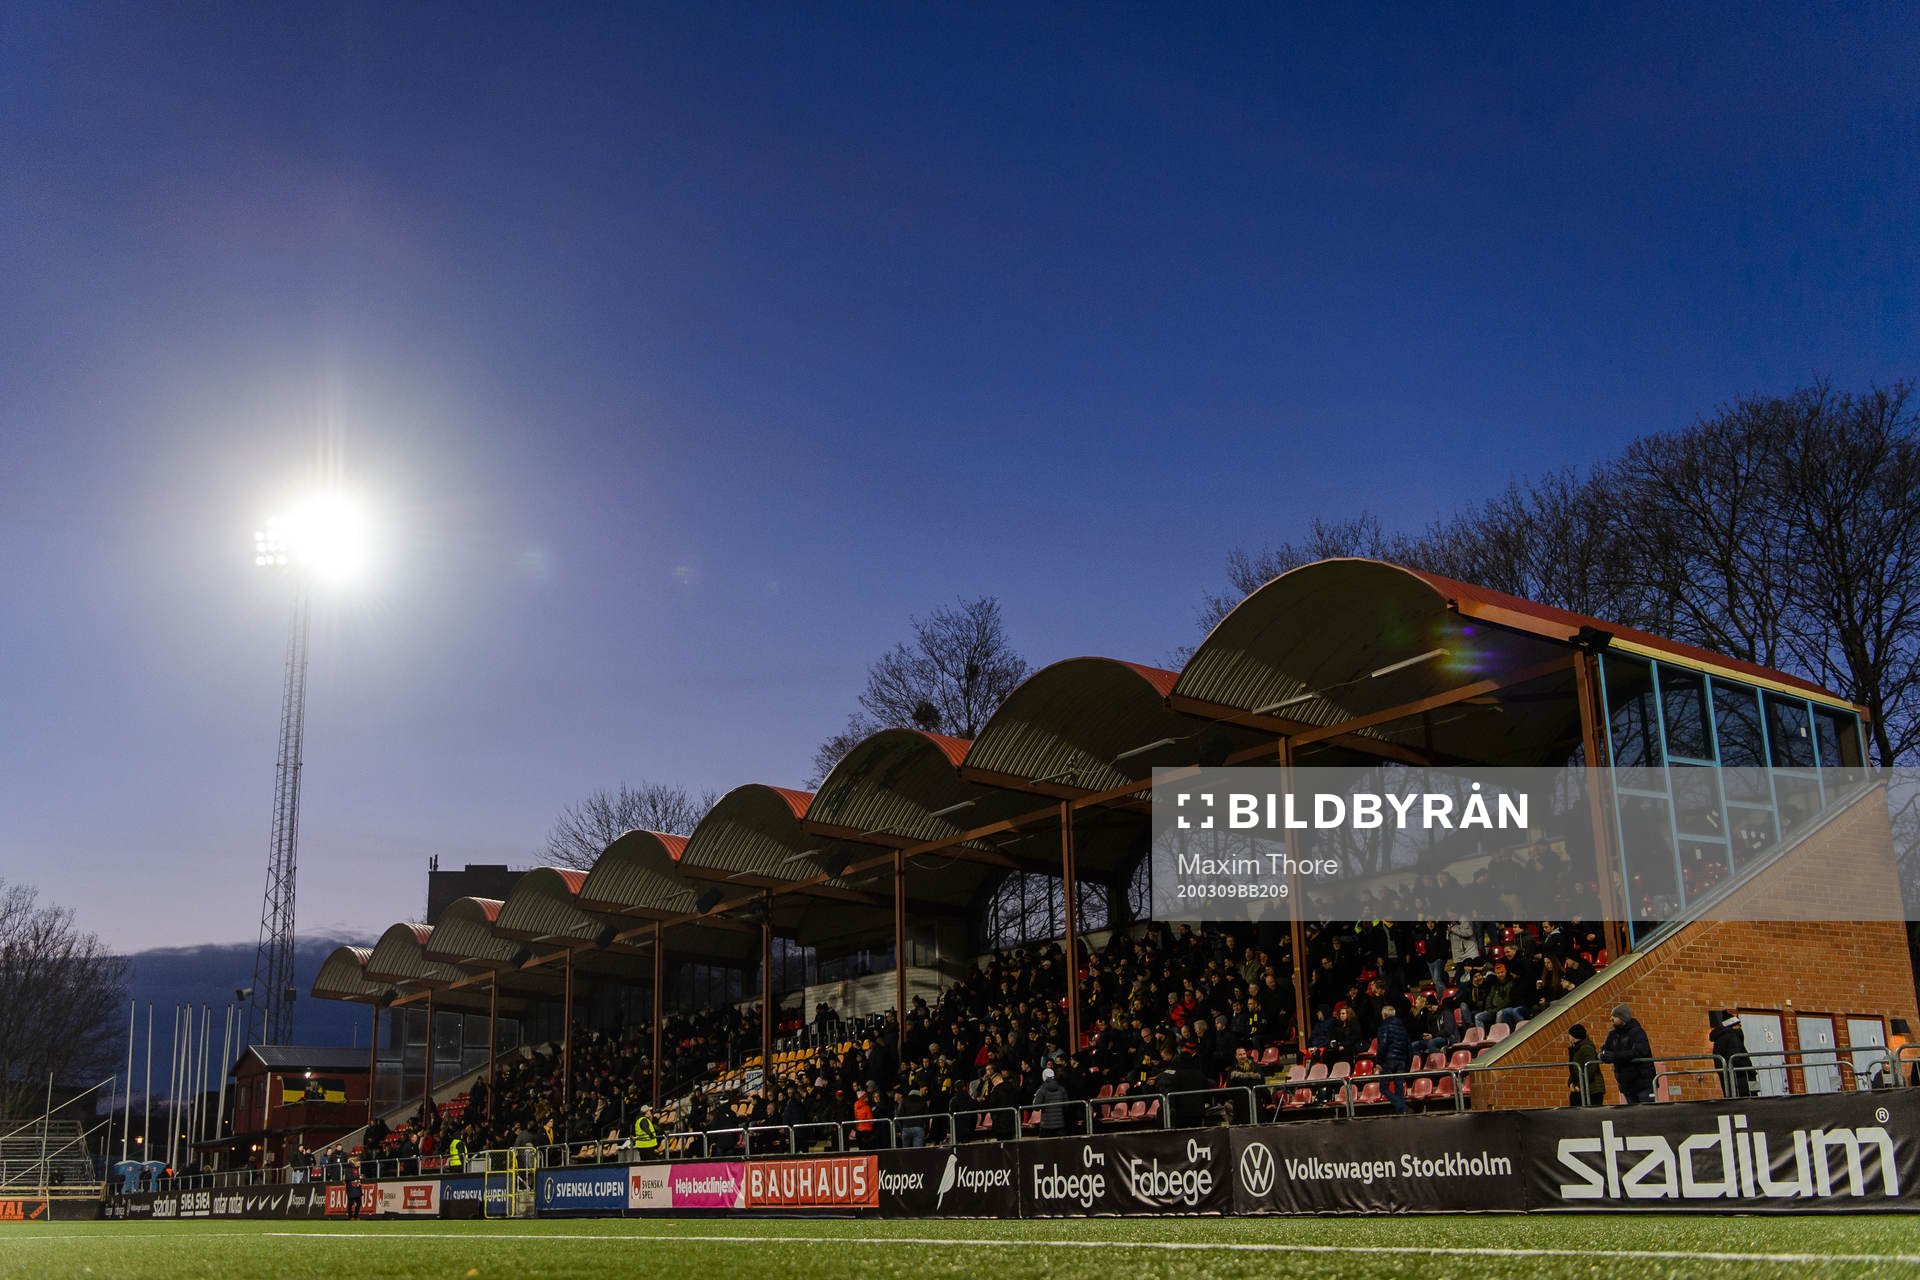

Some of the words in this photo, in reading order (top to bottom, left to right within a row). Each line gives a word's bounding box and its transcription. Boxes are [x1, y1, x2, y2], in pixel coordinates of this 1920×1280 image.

[1285, 1157, 1396, 1184] Volkswagen
[1400, 1151, 1512, 1178] Stockholm
[1556, 1114, 1899, 1198] stadium
[556, 1182, 593, 1197] SVENSKA
[594, 1181, 624, 1196] CUPEN
[642, 1180, 664, 1189] SVENSKA
[675, 1177, 692, 1197] Heja
[751, 1165, 866, 1198] BAUHAUS
[878, 1168, 924, 1194] Kappex
[957, 1164, 1012, 1193] Kappex
[1034, 1163, 1106, 1208] Fabege
[1130, 1158, 1213, 1206] Fabege
[180, 1193, 194, 1210] SVEA
[195, 1191, 210, 1209] SVEA
[329, 1188, 374, 1208] BAUUS
[642, 1190, 653, 1199] SPEL
